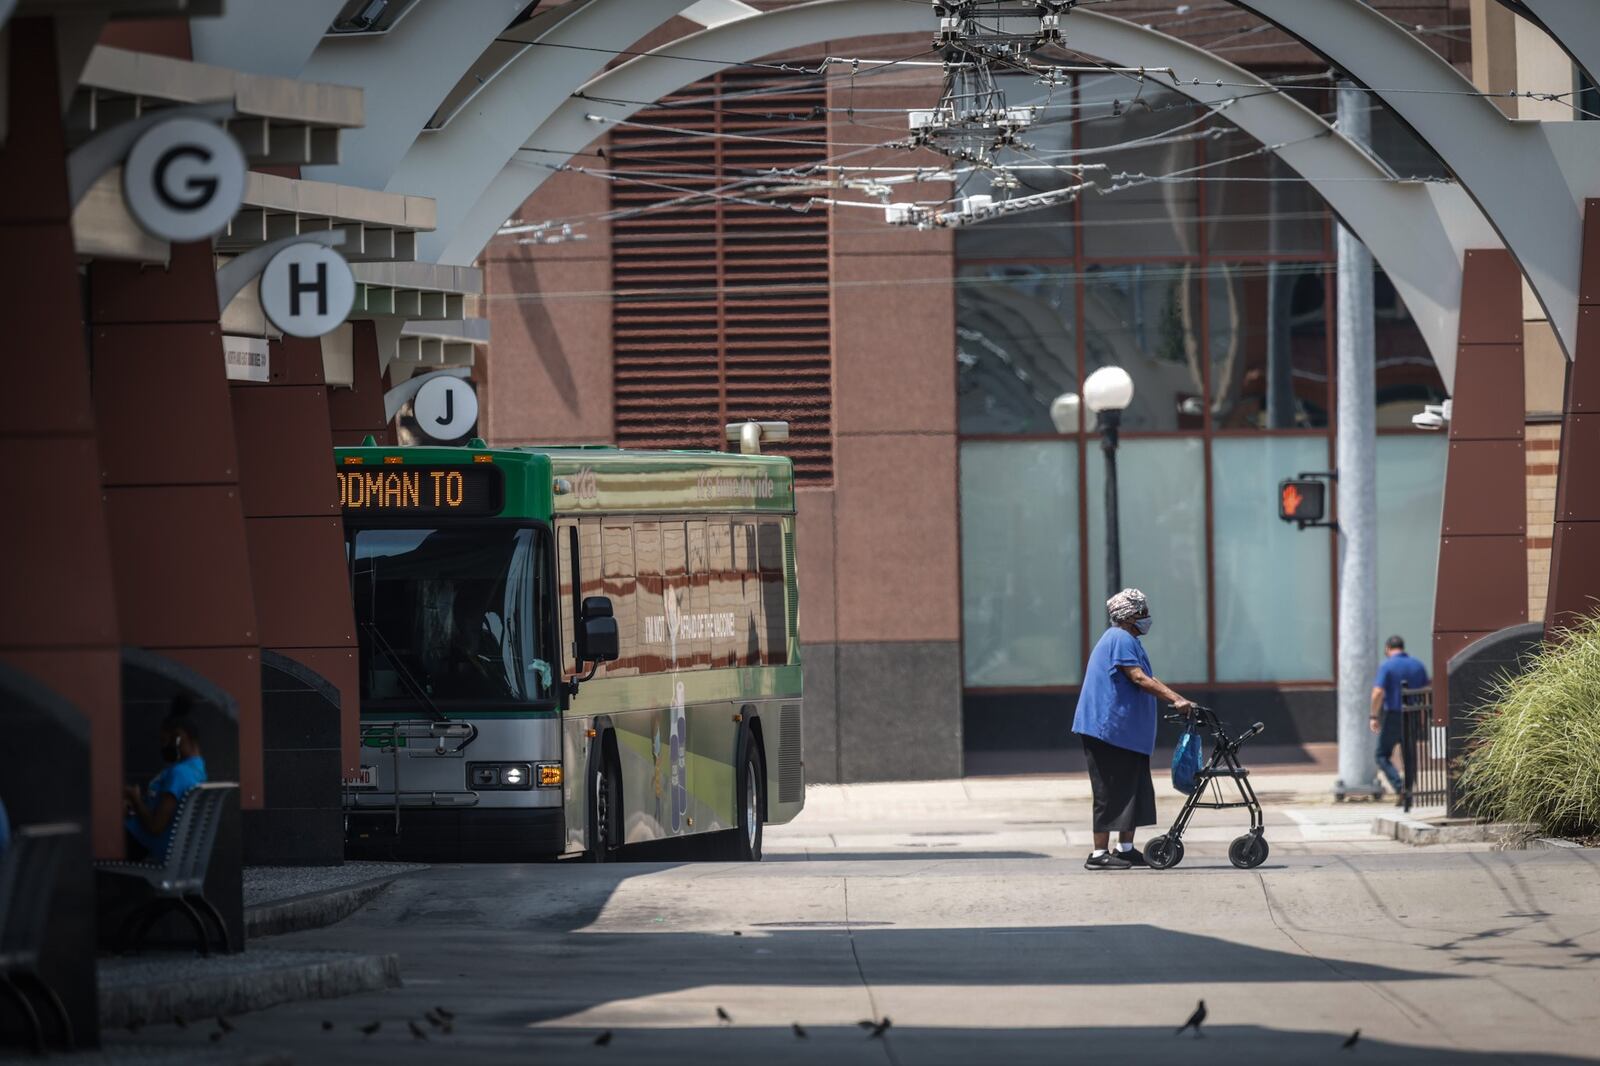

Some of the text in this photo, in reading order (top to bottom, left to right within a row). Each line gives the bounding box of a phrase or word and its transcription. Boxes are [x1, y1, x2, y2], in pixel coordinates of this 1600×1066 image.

[152, 145, 219, 212] G
[289, 263, 327, 316] H
[435, 389, 453, 425] J
[430, 472, 463, 507] TO
[754, 471, 774, 498] ride
